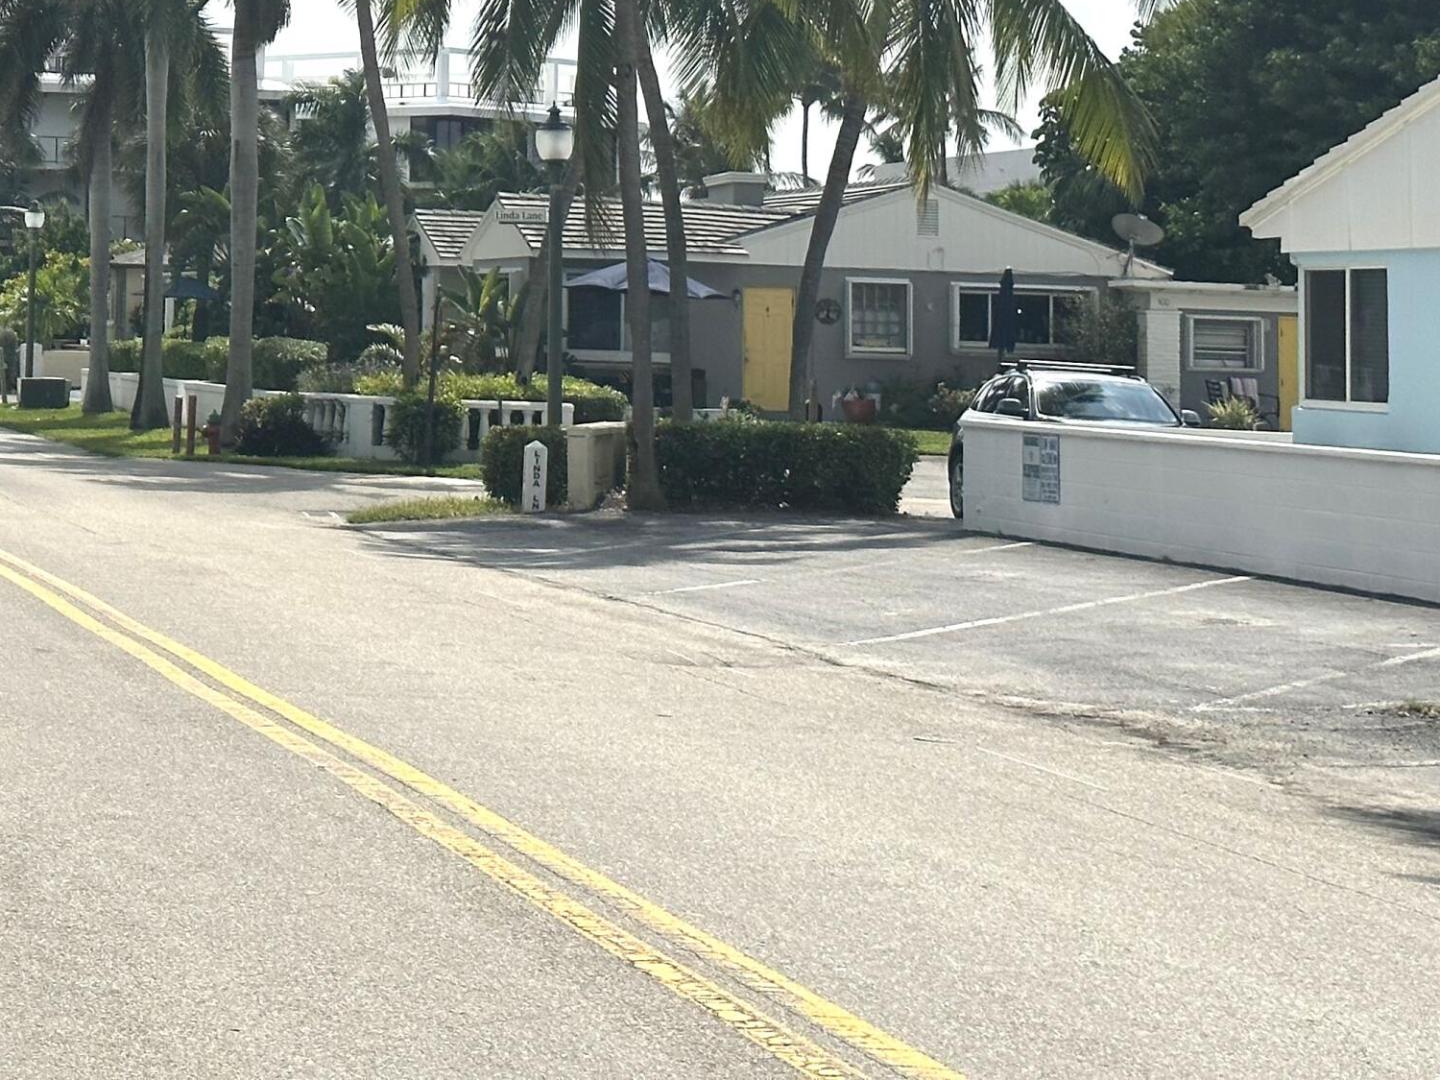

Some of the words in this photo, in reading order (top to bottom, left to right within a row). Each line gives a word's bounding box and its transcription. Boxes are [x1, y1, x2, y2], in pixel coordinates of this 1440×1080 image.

[495, 210, 520, 220] Linda
[522, 211, 543, 220] Lane
[532, 450, 541, 487] LINDA
[531, 495, 540, 510] LN
